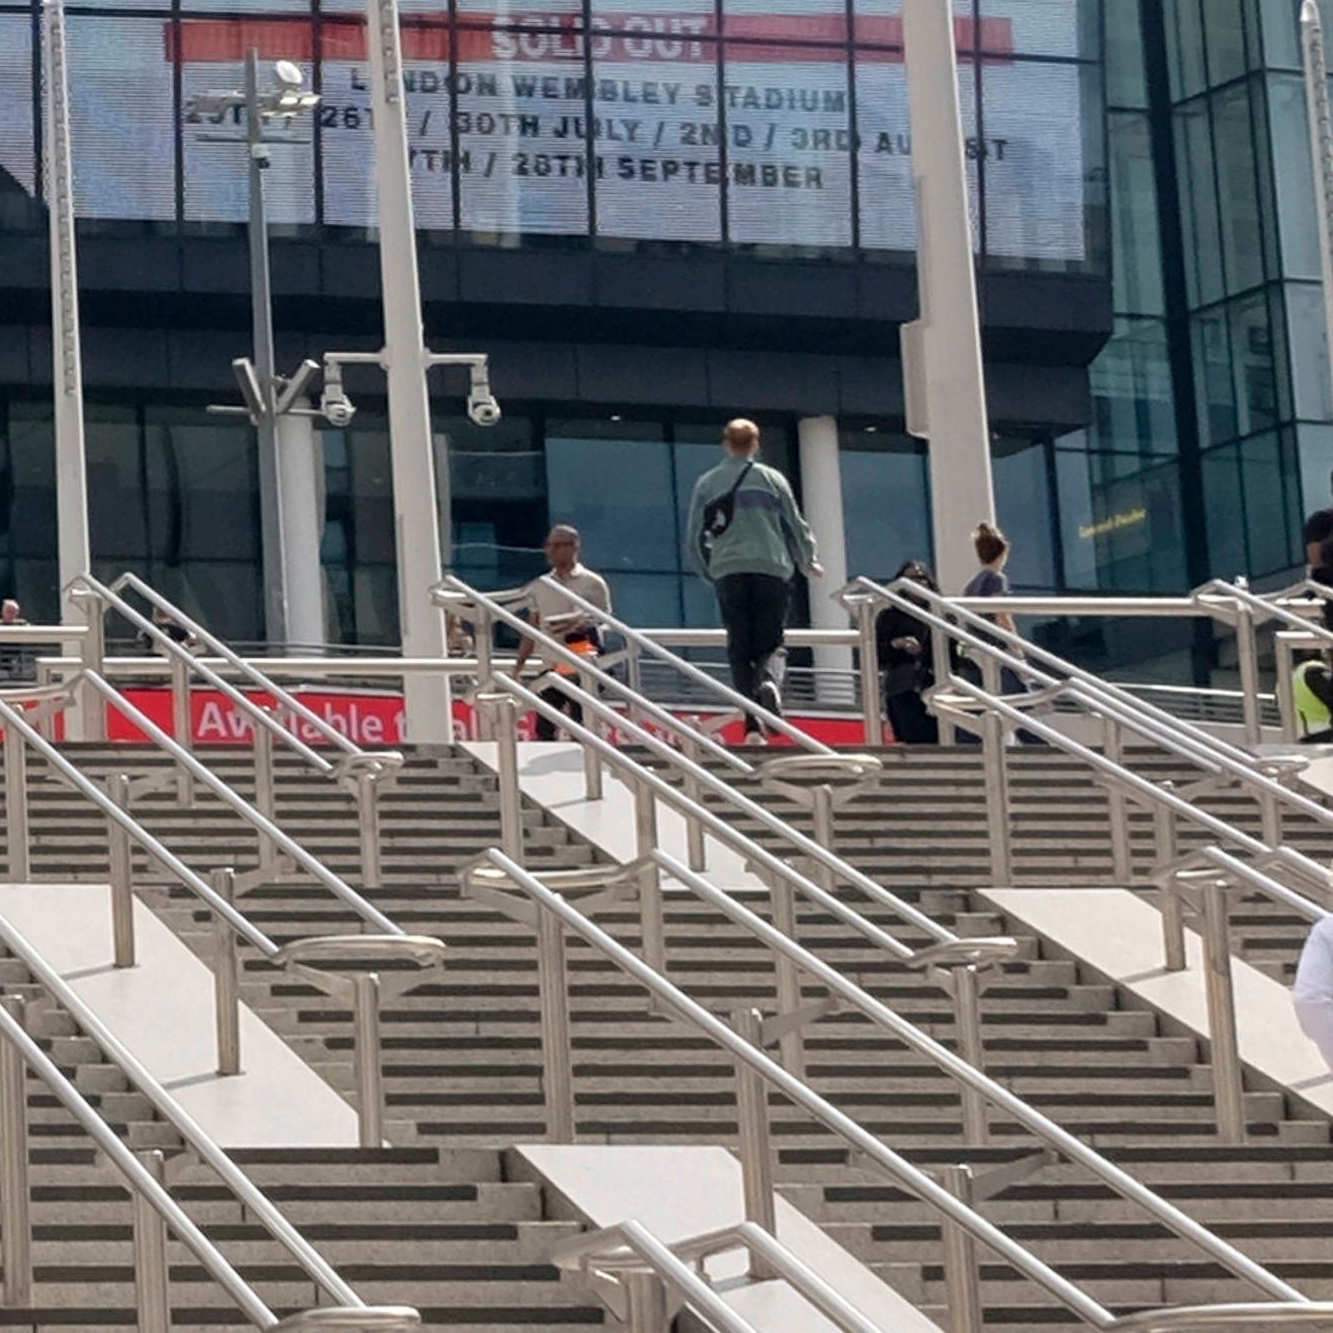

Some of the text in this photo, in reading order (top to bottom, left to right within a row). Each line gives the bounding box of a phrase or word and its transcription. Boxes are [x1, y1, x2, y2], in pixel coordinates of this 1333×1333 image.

[492, 15, 707, 60] SOLD OUT
[351, 68, 847, 113] LNDON WEMBLEY STADIUM
[553, 114, 640, 142] JULY
[680, 123, 753, 149] 2ND
[790, 127, 860, 154] 3RD
[617, 157, 823, 189] SEPTEMBER
